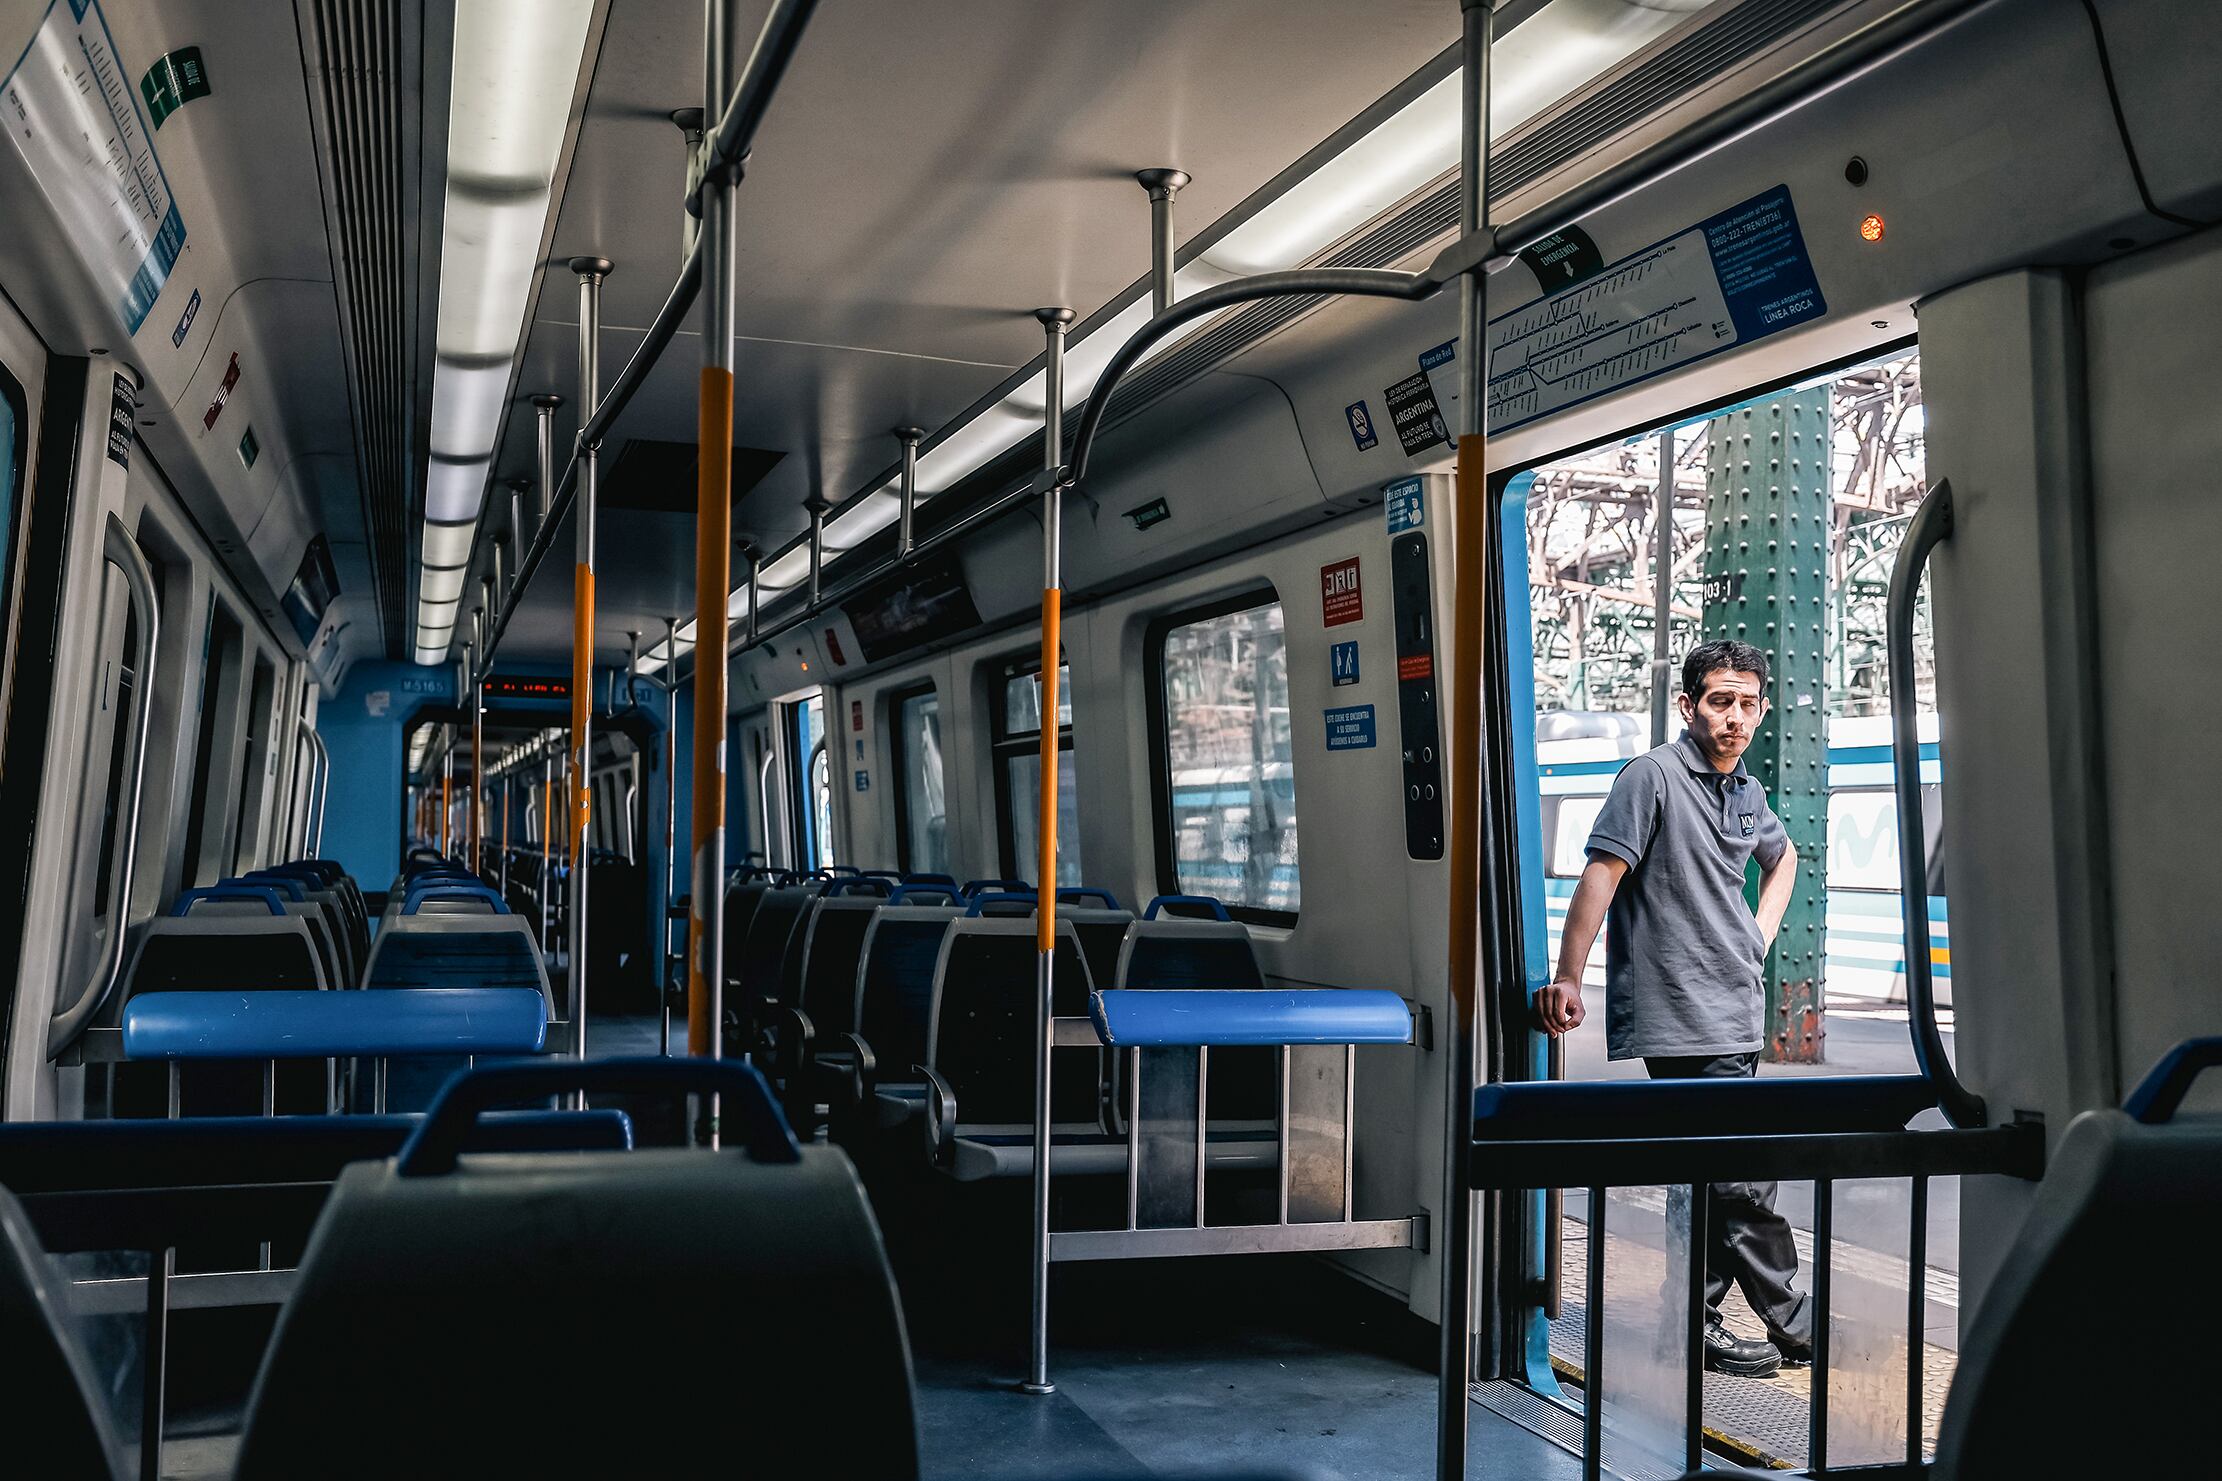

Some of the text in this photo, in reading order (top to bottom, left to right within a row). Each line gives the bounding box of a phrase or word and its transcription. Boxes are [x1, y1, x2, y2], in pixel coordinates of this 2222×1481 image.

[1708, 224, 1726, 236] Centro
[1532, 234, 1564, 254] SALIDA DE
[1540, 242, 1580, 266] EMERGENCIA
[1761, 288, 1814, 312] TRENES ARGENTINOS
[1764, 298, 1814, 324] LÍNEA ROCA
[1422, 347, 1452, 366] Plano de Red
[1396, 386, 1402, 394] DE
[1395, 398, 1434, 426] ARGENTINA
[1400, 421, 1430, 440] AL FUTURO SE
[1415, 435, 1422, 444] EN
[1421, 430, 1434, 440] TREN
[1326, 714, 1334, 724] ESTE
[1345, 712, 1350, 721] SE
[1350, 711, 1370, 720] ENCUENTRA
